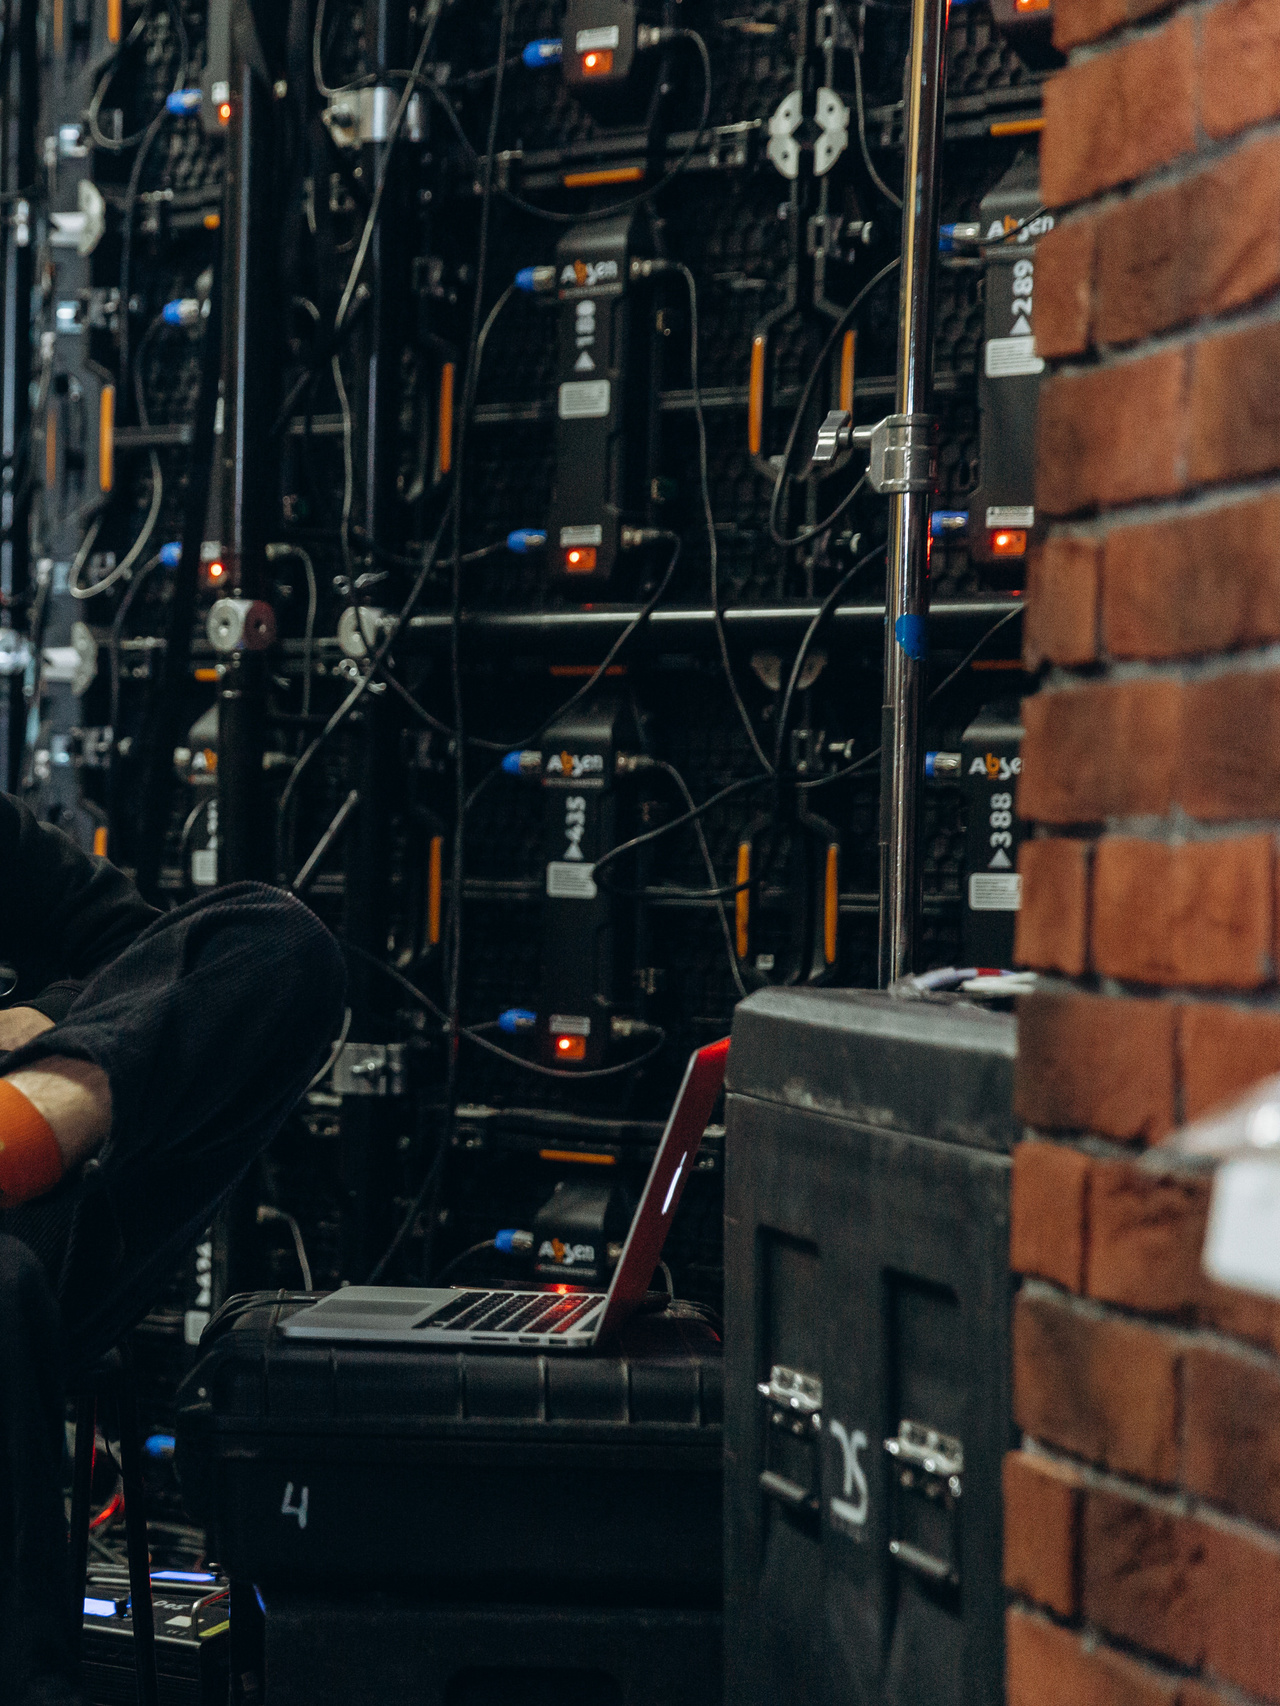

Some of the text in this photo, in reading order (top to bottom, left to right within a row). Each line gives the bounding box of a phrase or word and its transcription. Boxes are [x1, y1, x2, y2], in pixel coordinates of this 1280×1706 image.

[987, 214, 1055, 244] Absen
[1010, 259, 1034, 316] 289
[969, 753, 1024, 781] Abse
[990, 792, 1012, 849] 388
[281, 1481, 309, 1529] 4
